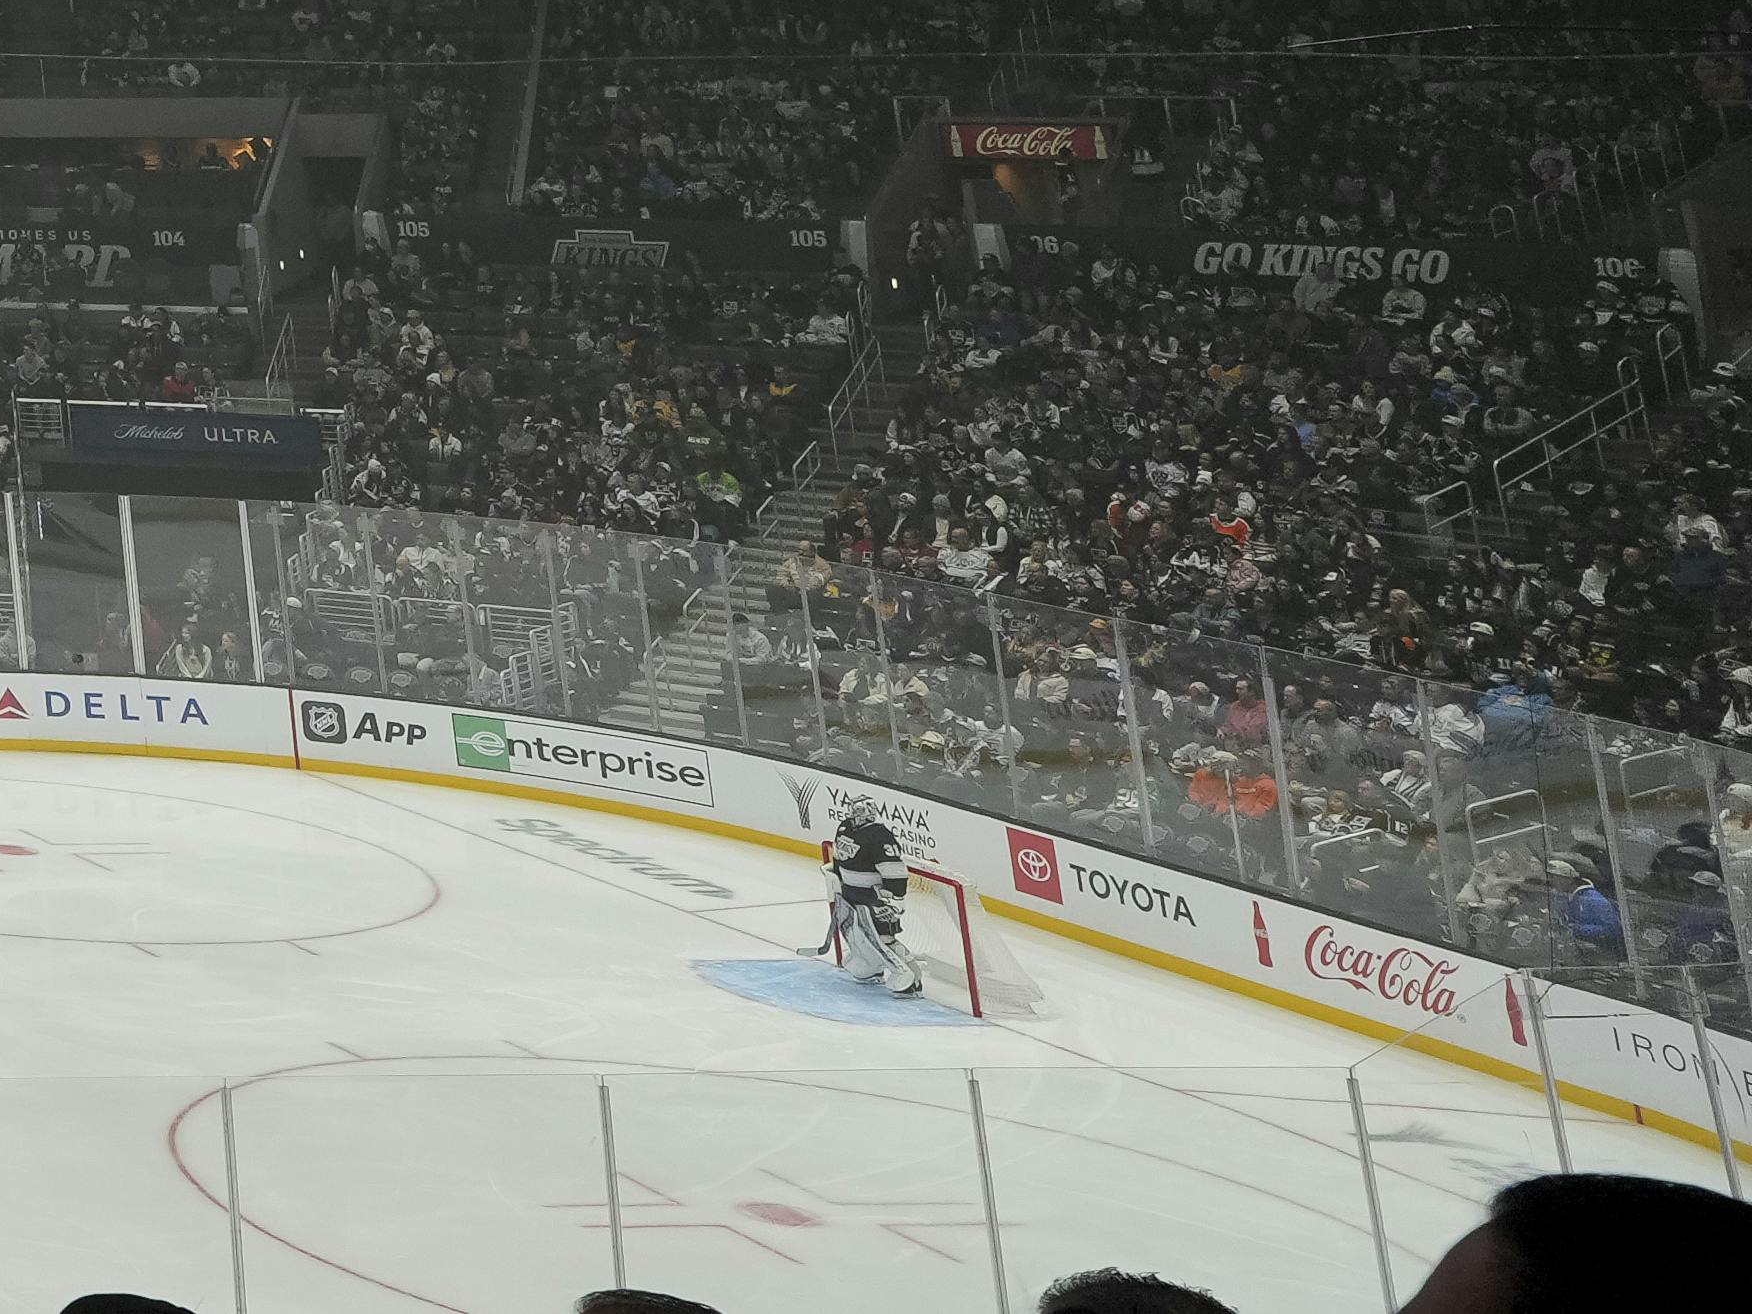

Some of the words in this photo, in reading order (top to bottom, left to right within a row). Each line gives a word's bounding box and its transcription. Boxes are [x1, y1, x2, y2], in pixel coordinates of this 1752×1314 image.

[152, 230, 186, 247] 104
[1391, 249, 1450, 284] GO
[113, 422, 184, 443] Michelob
[203, 427, 279, 445] ULTRA
[45, 690, 209, 727] DELTA
[1069, 862, 1197, 928] TOYOTA
